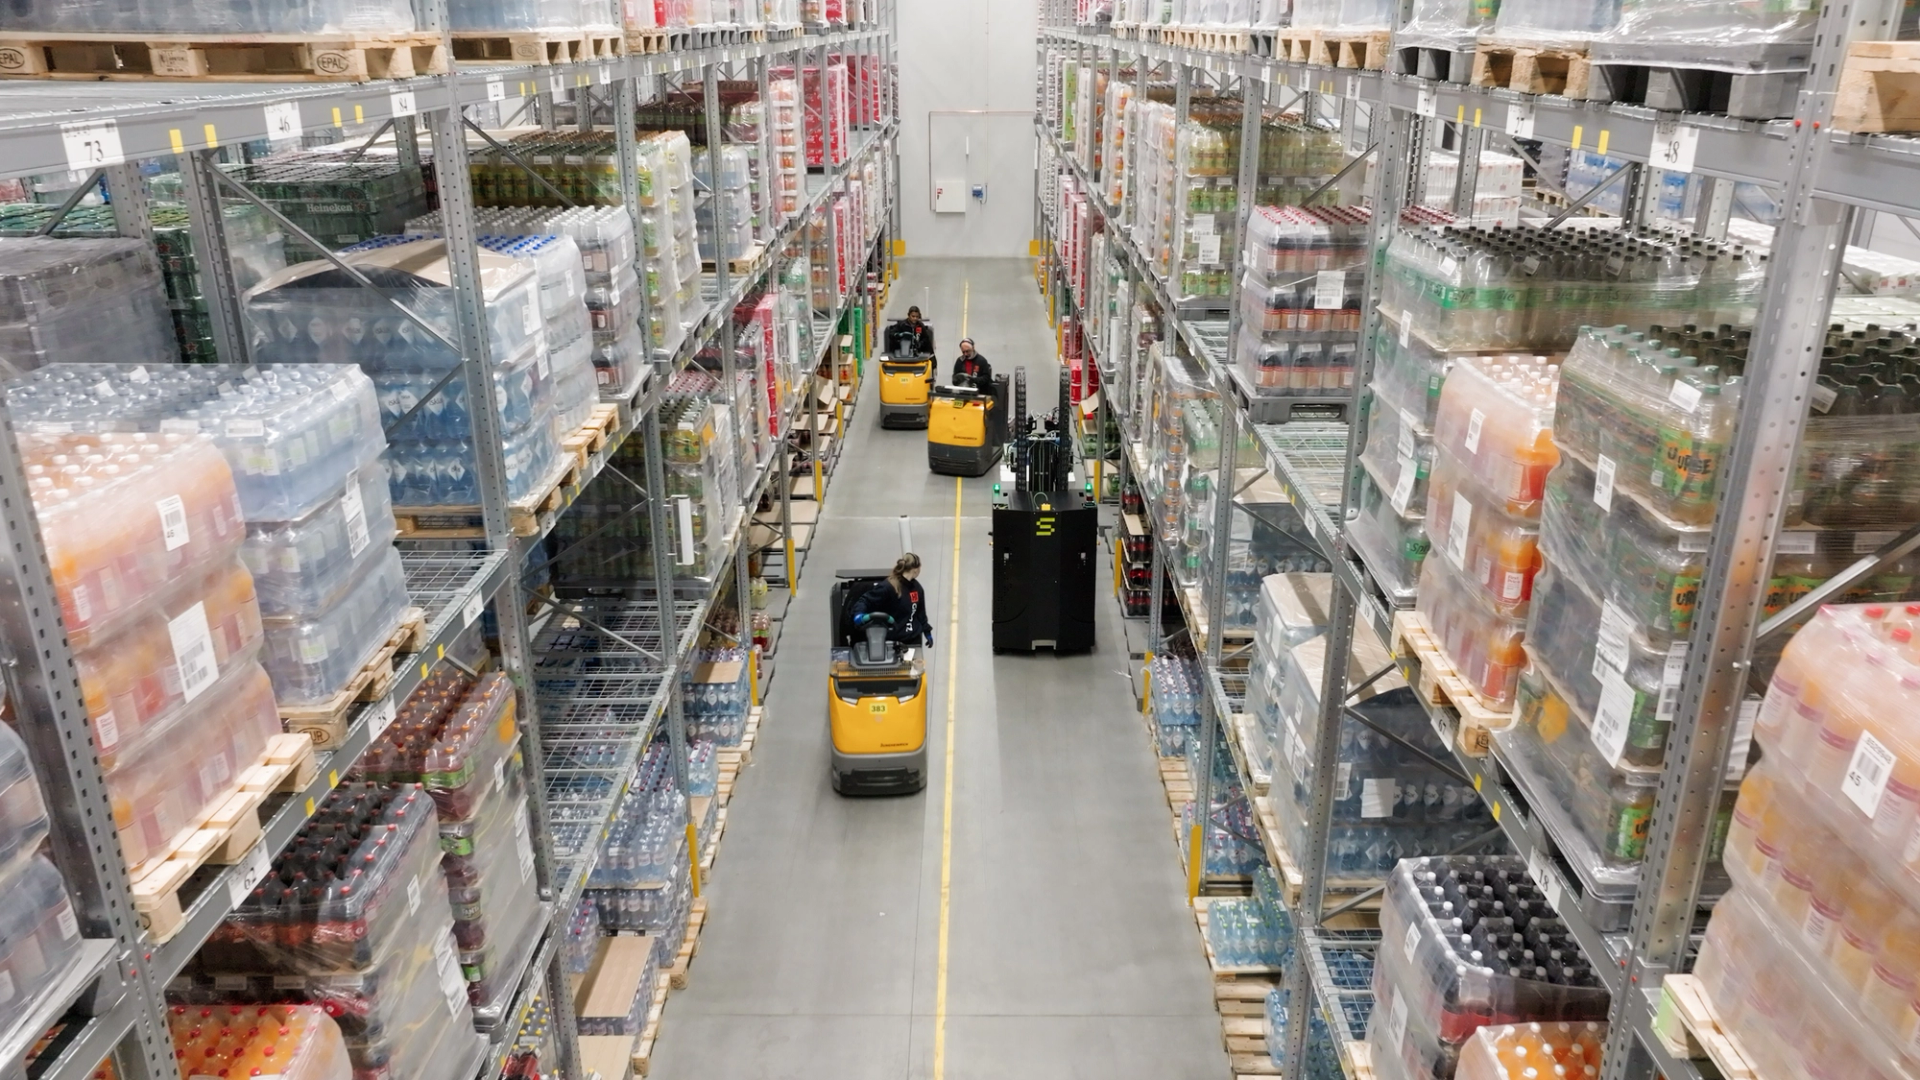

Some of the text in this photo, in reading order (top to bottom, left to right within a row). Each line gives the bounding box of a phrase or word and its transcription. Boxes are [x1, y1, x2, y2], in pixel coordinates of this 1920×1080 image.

[321, 57, 345, 70] EPAL
[279, 116, 291, 134] 46
[84, 140, 104, 163] 73
[1664, 140, 1680, 164] 48
[307, 203, 353, 213] Heineken
[871, 705, 886, 713] 383
[377, 711, 387, 731] 28
[1438, 719, 1447, 736] 67
[1848, 771, 1863, 787] 45
[243, 866, 257, 891] 62
[1538, 869, 1550, 892] 18
